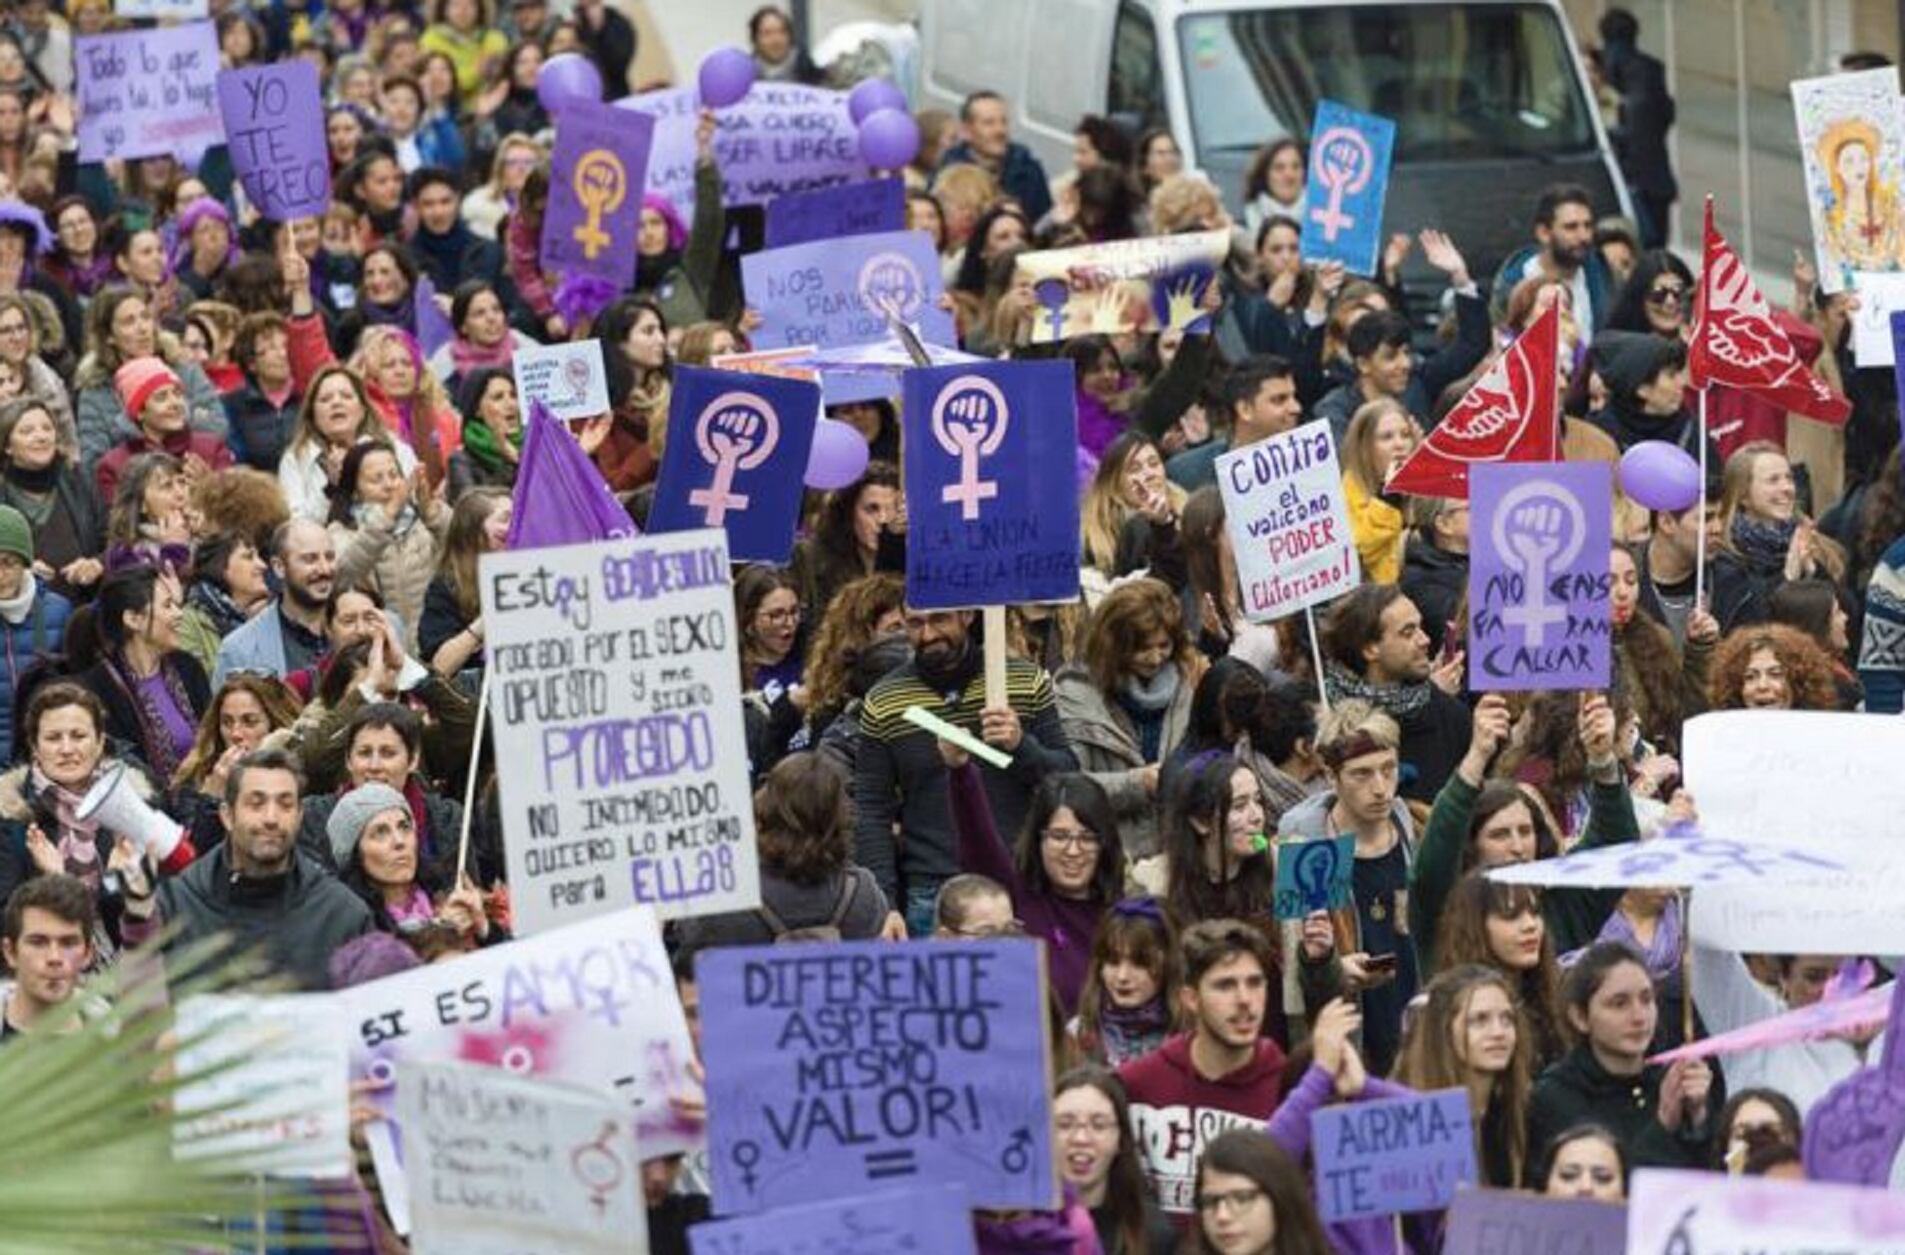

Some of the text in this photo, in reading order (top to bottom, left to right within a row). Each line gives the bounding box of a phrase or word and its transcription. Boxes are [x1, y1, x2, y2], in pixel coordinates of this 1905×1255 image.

[243, 74, 289, 121] YO
[234, 123, 295, 167] TE
[767, 268, 824, 299] NOS
[1279, 482, 1299, 509] el
[1269, 516, 1336, 564] PODER
[1484, 571, 1610, 607] NO ENS
[655, 609, 726, 654] SEXO
[504, 669, 607, 725] OPUESTO
[528, 802, 559, 839] NO
[524, 816, 741, 877] QUIERO LO MISMO
[743, 952, 1004, 1008] DIFERENTE
[361, 1010, 411, 1048] SI
[436, 980, 492, 1026] ES
[776, 1003, 989, 1051] ASPECTO
[797, 1046, 938, 1094] MISMO
[762, 1084, 982, 1151] VALOR!
[1324, 1164, 1375, 1216] TE
